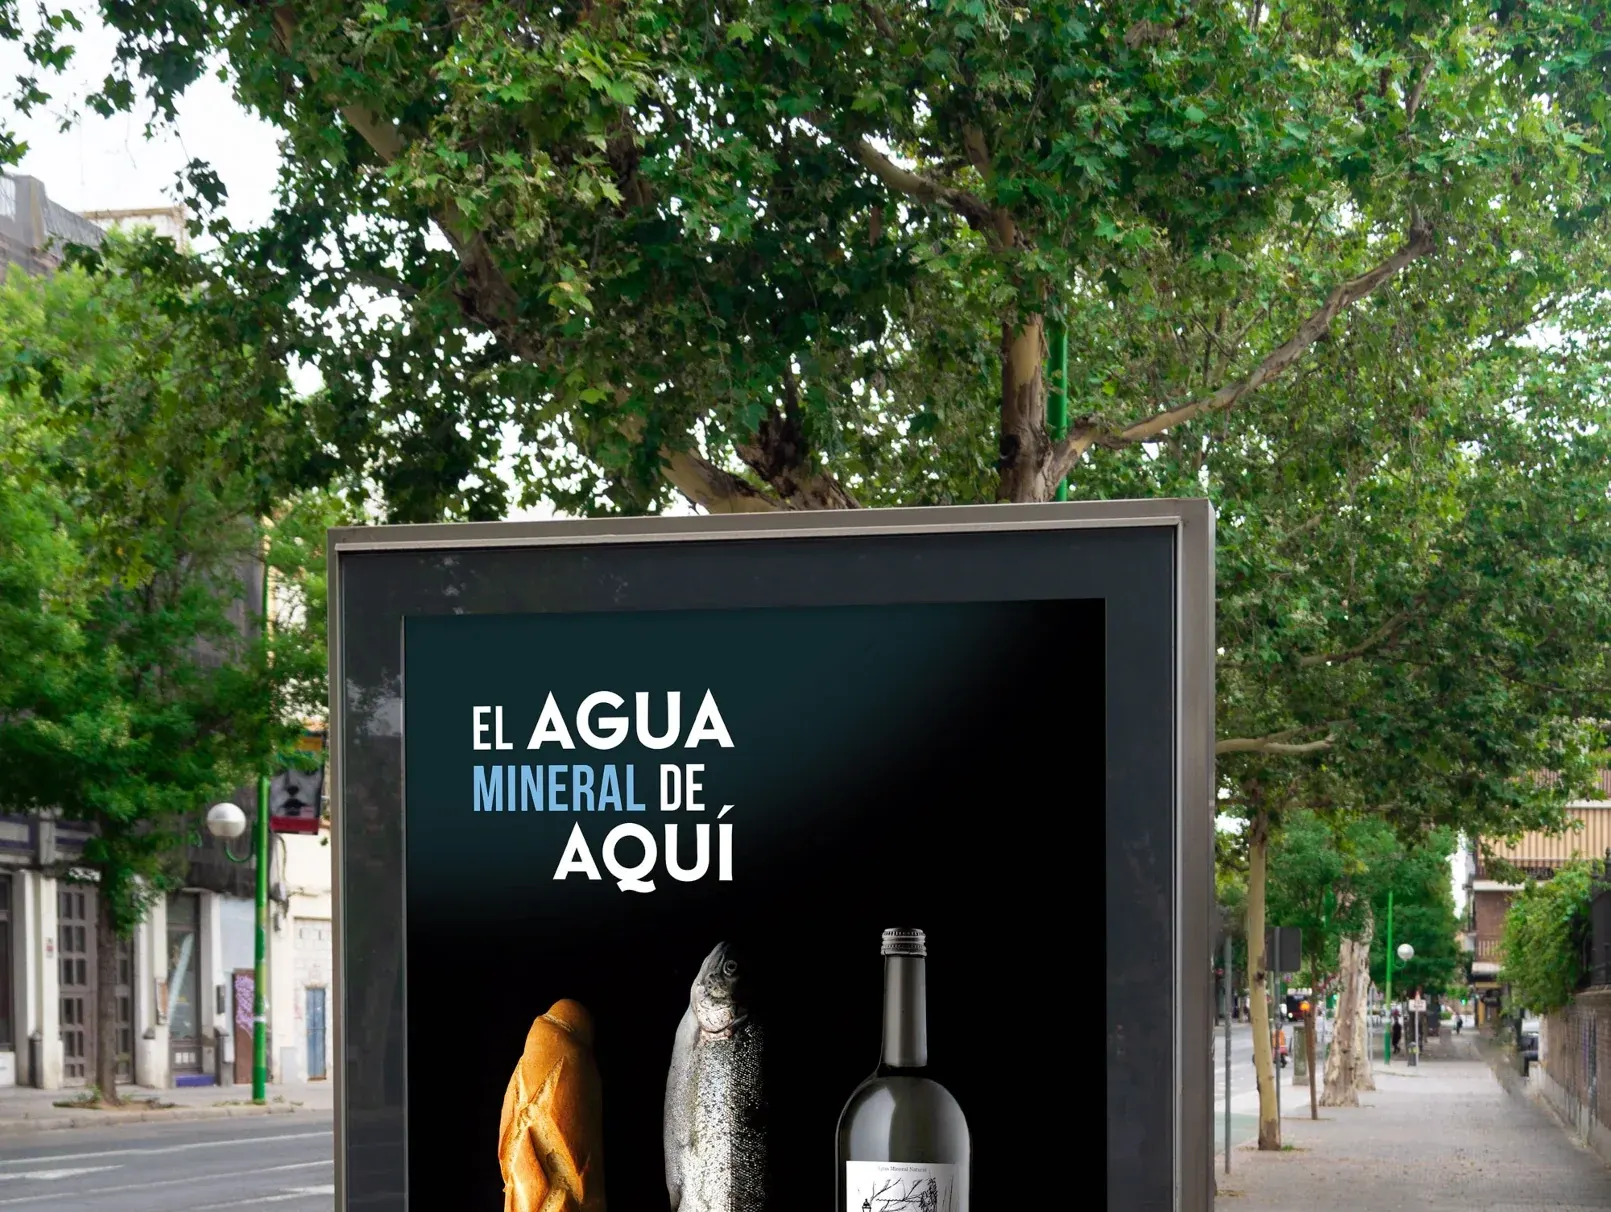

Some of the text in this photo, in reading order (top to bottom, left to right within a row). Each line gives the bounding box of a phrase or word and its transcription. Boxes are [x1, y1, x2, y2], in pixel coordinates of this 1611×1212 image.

[473, 688, 735, 750] EL AGUA
[473, 763, 705, 812] MINERAL DE
[552, 804, 735, 894] AQUÍ
